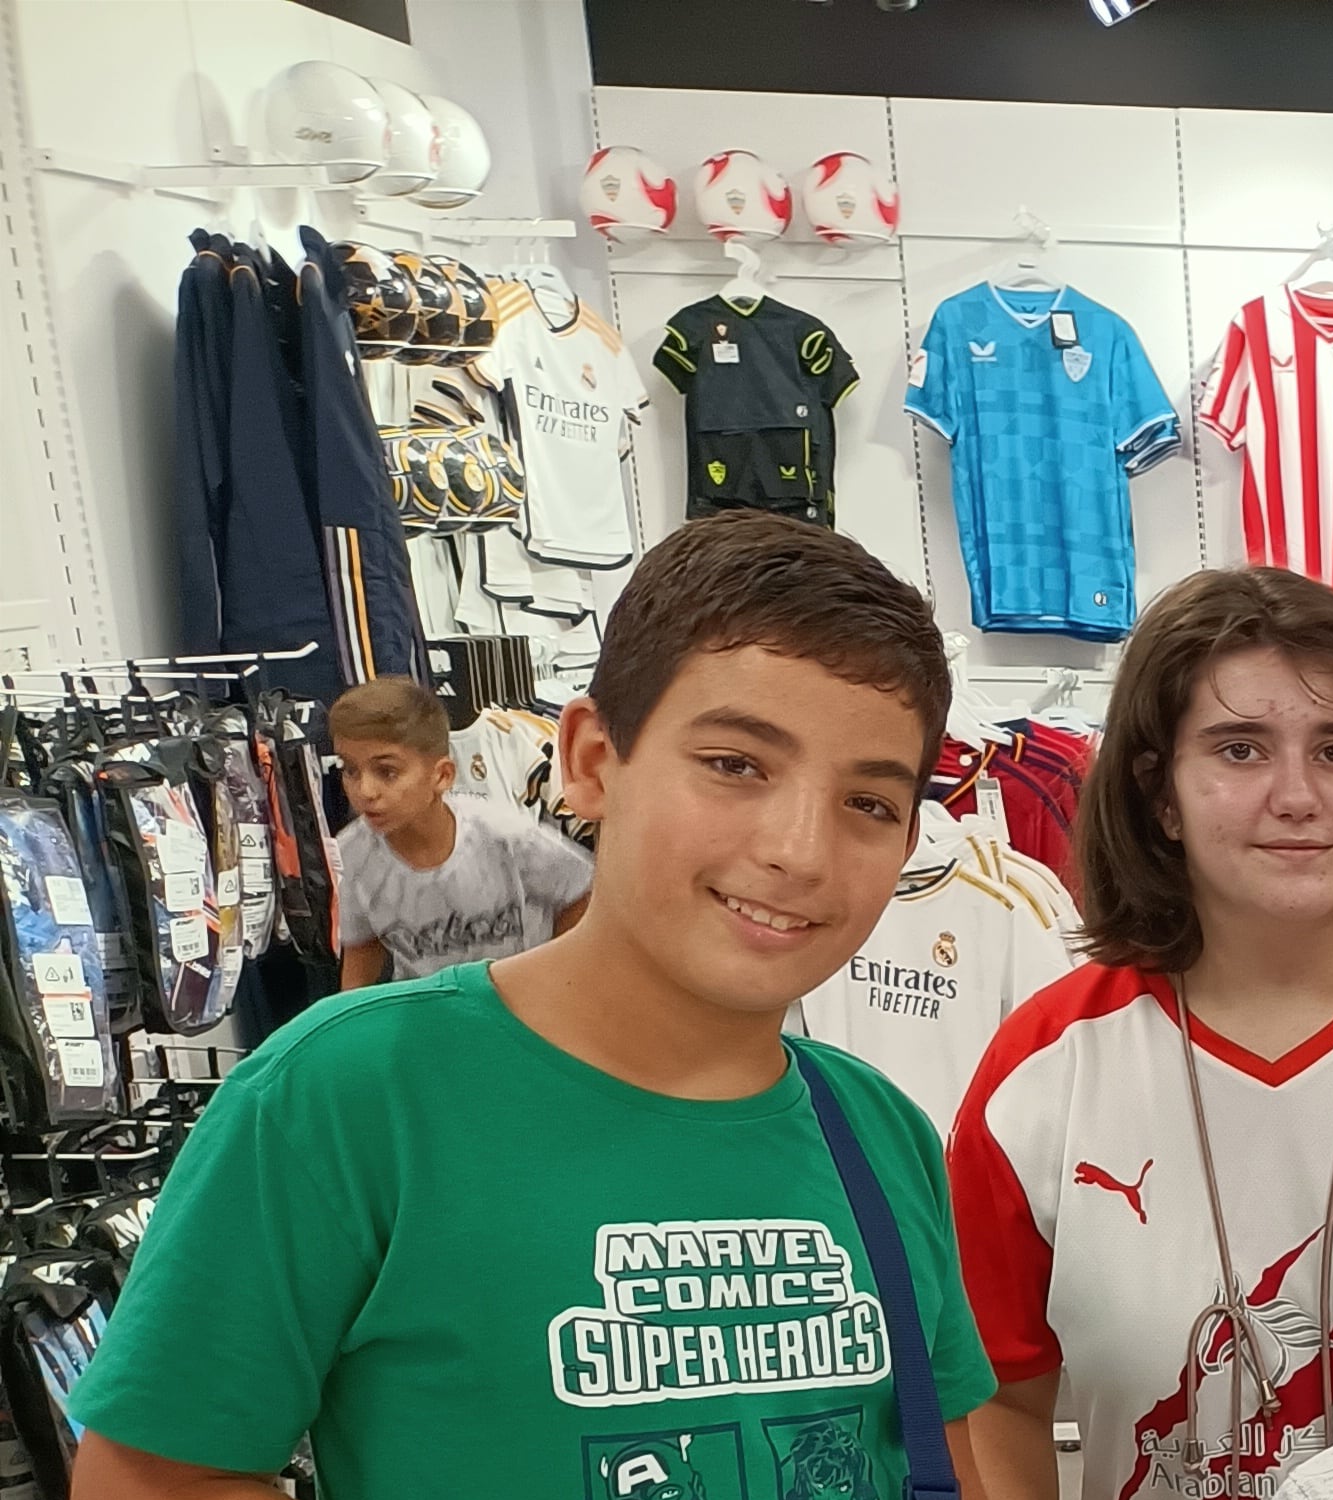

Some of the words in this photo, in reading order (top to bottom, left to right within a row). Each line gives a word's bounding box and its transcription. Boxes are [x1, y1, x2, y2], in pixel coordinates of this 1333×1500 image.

[525, 384, 609, 423] Emirates
[606, 1230, 844, 1274] MARVEL
[616, 1270, 848, 1314] COMICS
[572, 1318, 730, 1396] SUPER
[734, 1301, 882, 1383] HEROES
